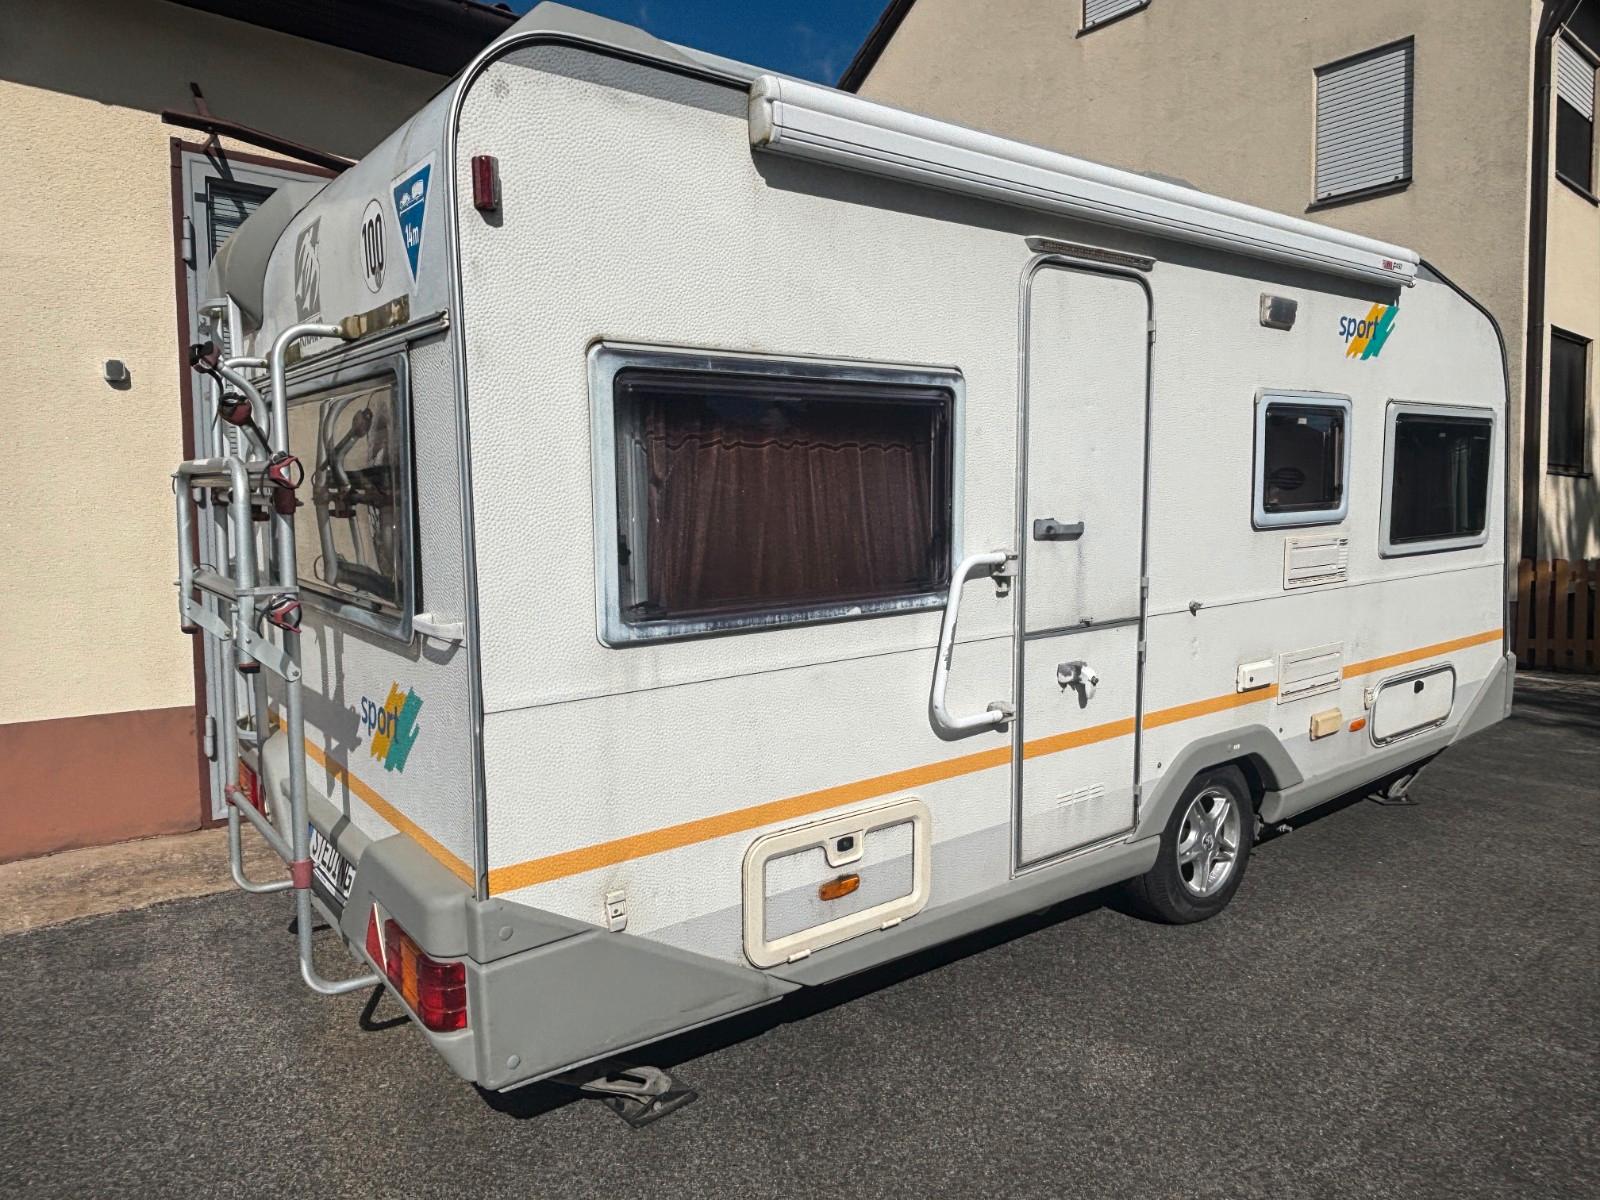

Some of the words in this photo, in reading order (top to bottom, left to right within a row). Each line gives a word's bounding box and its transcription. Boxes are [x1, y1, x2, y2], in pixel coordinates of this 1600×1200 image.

[362, 213, 384, 279] 100
[1339, 315, 1379, 343] sport
[361, 696, 400, 744] sport
